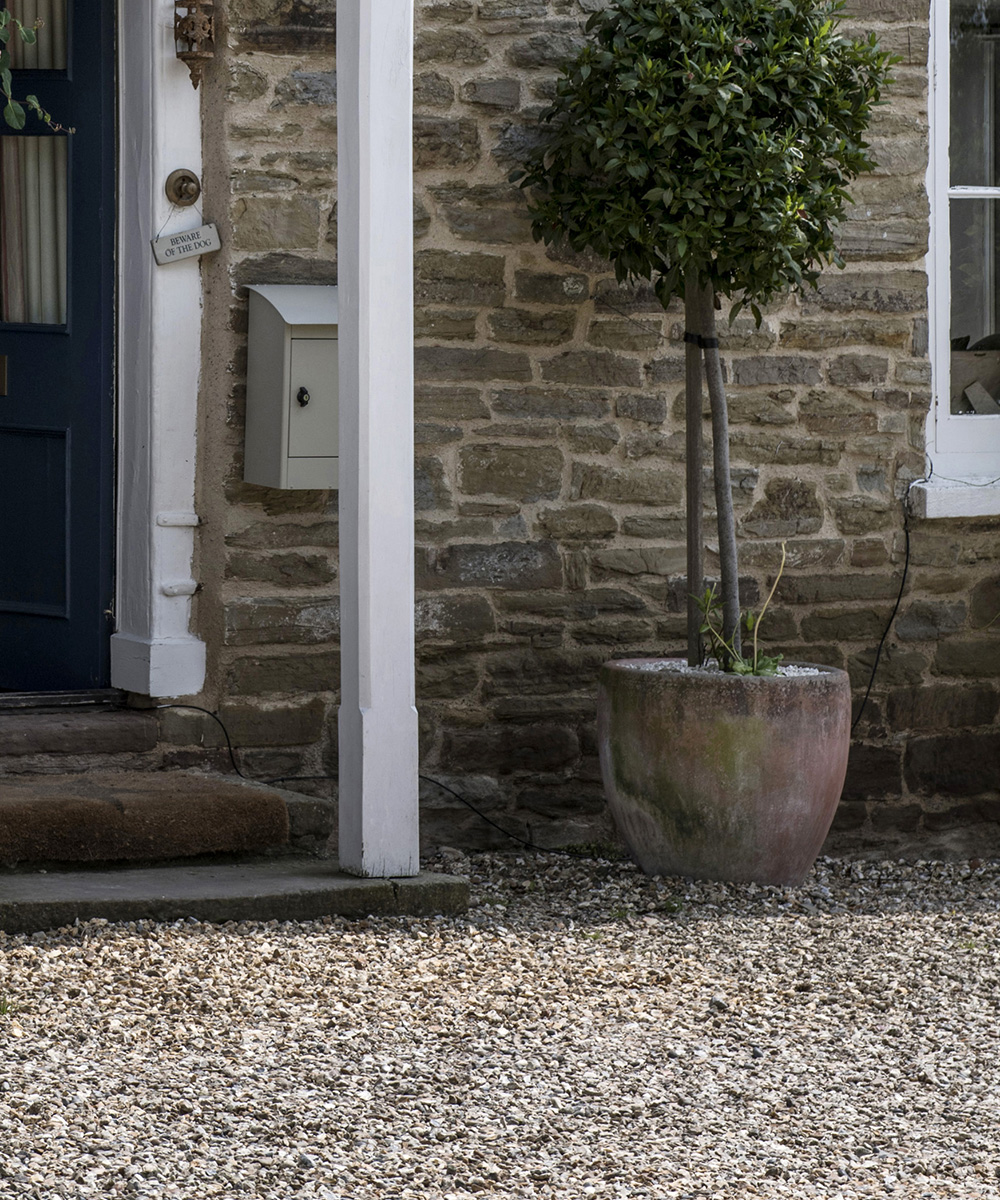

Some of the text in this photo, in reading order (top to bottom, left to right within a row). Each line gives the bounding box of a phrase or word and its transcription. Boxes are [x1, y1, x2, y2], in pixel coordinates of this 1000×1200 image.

[170, 231, 201, 246] BEWARE
[165, 239, 211, 257] OF THE DOG
